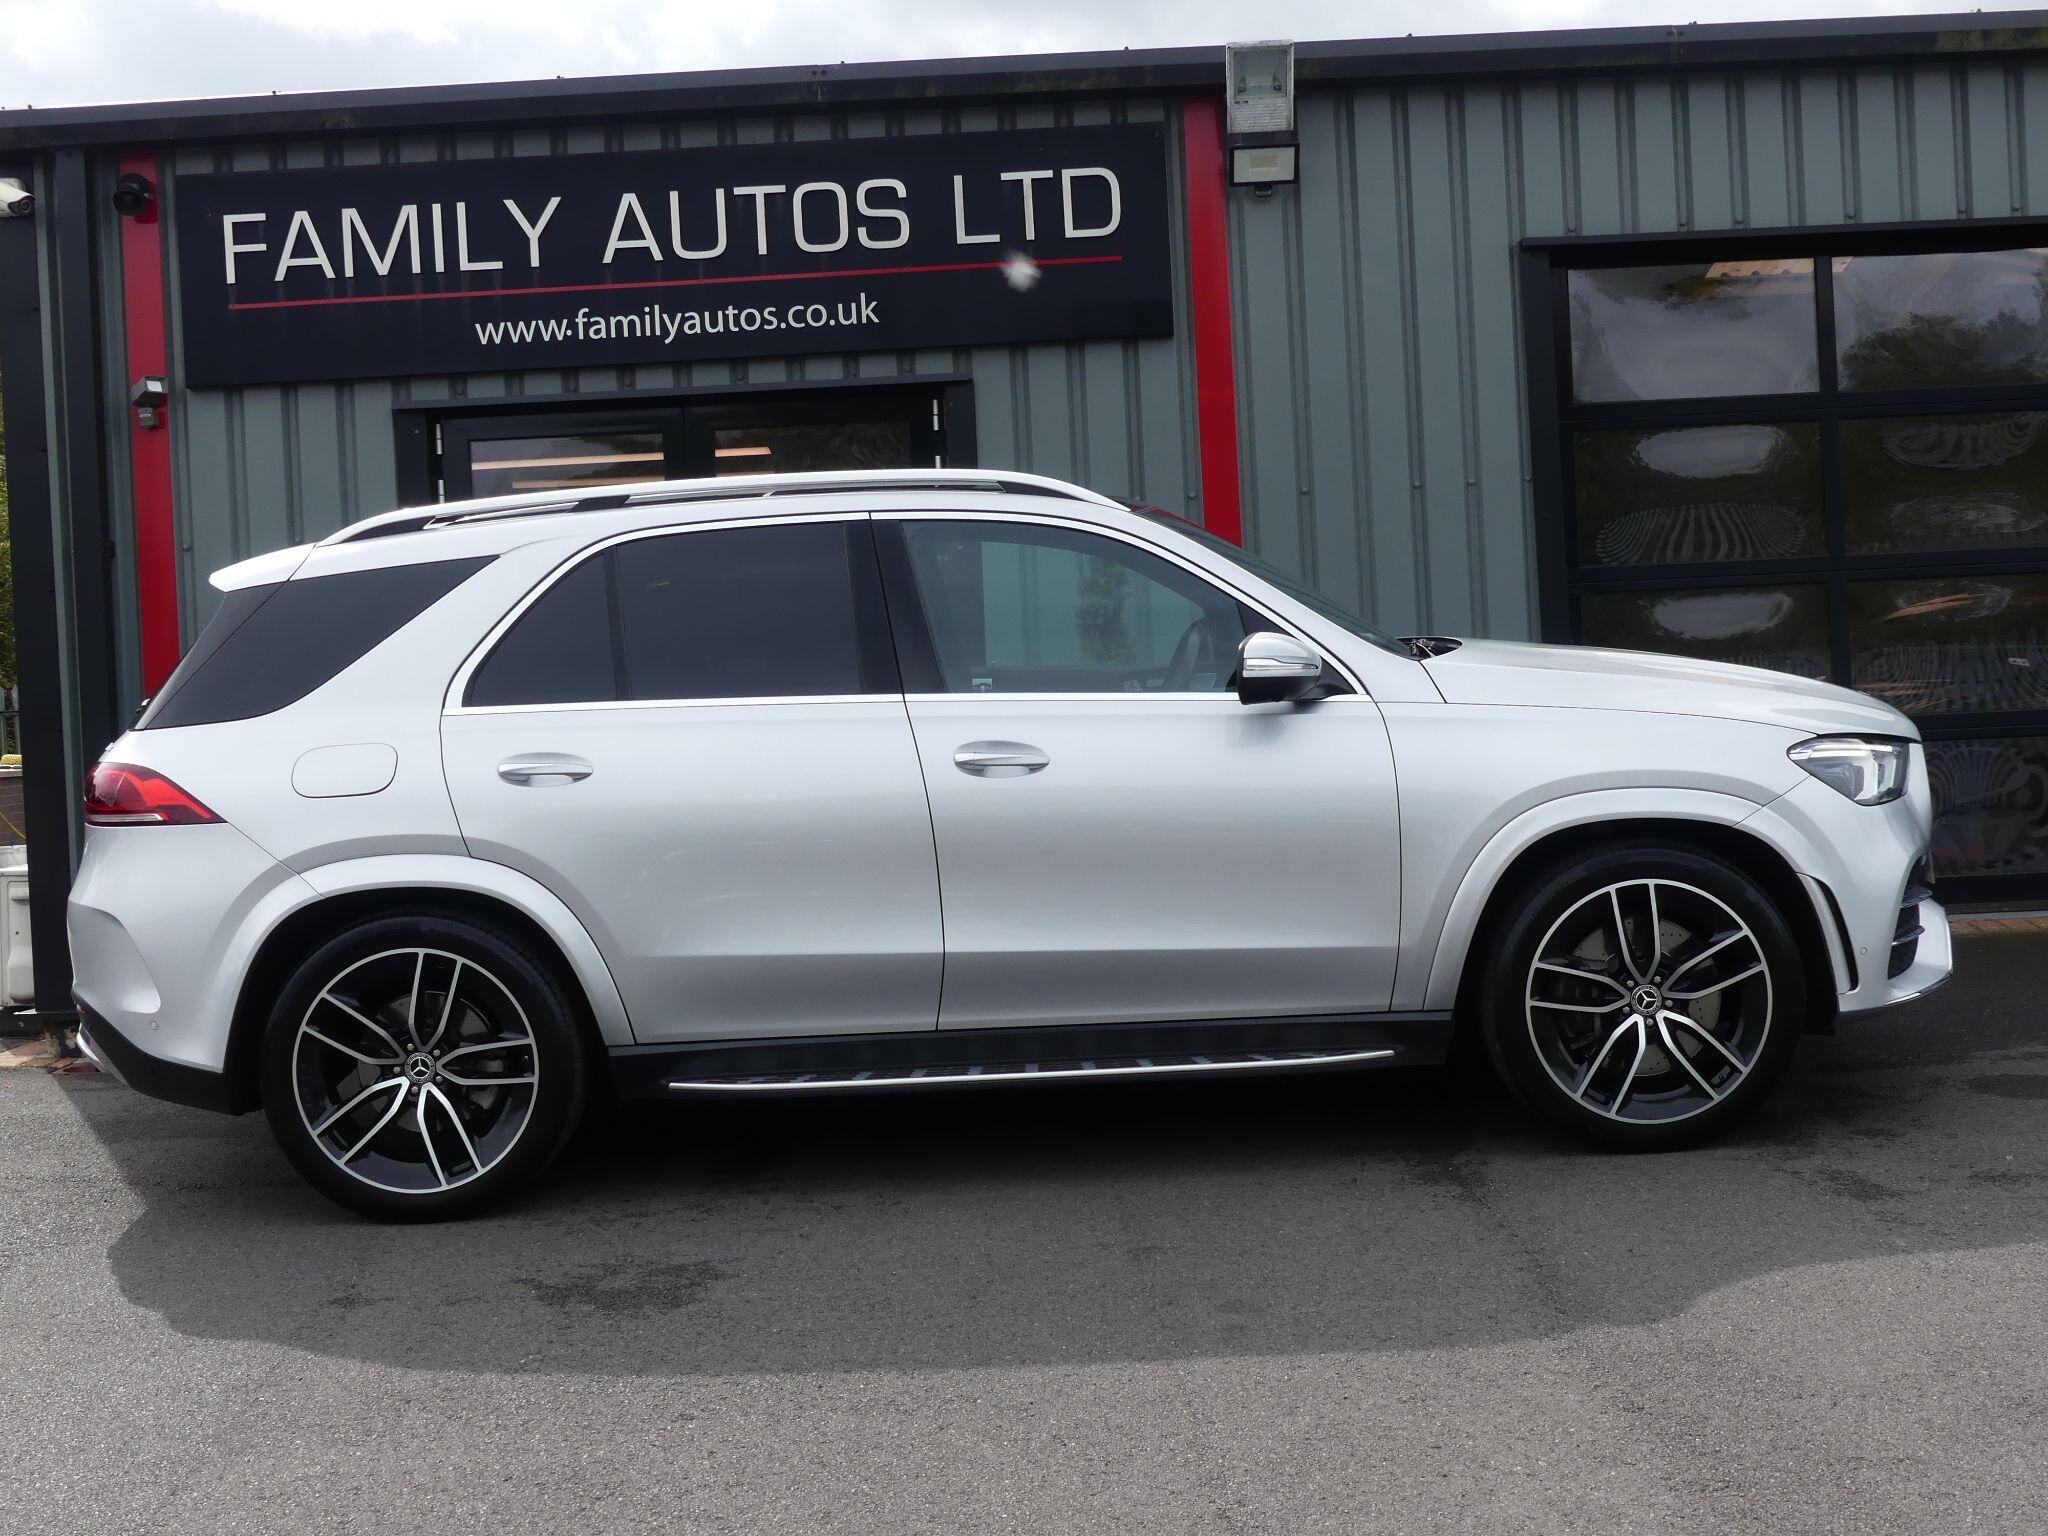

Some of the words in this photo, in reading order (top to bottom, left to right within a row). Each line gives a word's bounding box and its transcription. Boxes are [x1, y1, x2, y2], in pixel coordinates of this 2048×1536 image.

[222, 196, 562, 284] FAMILY
[602, 178, 909, 264] AUTOS
[953, 166, 1122, 245] LTD
[474, 292, 879, 345] www.familyautos.co.uk
